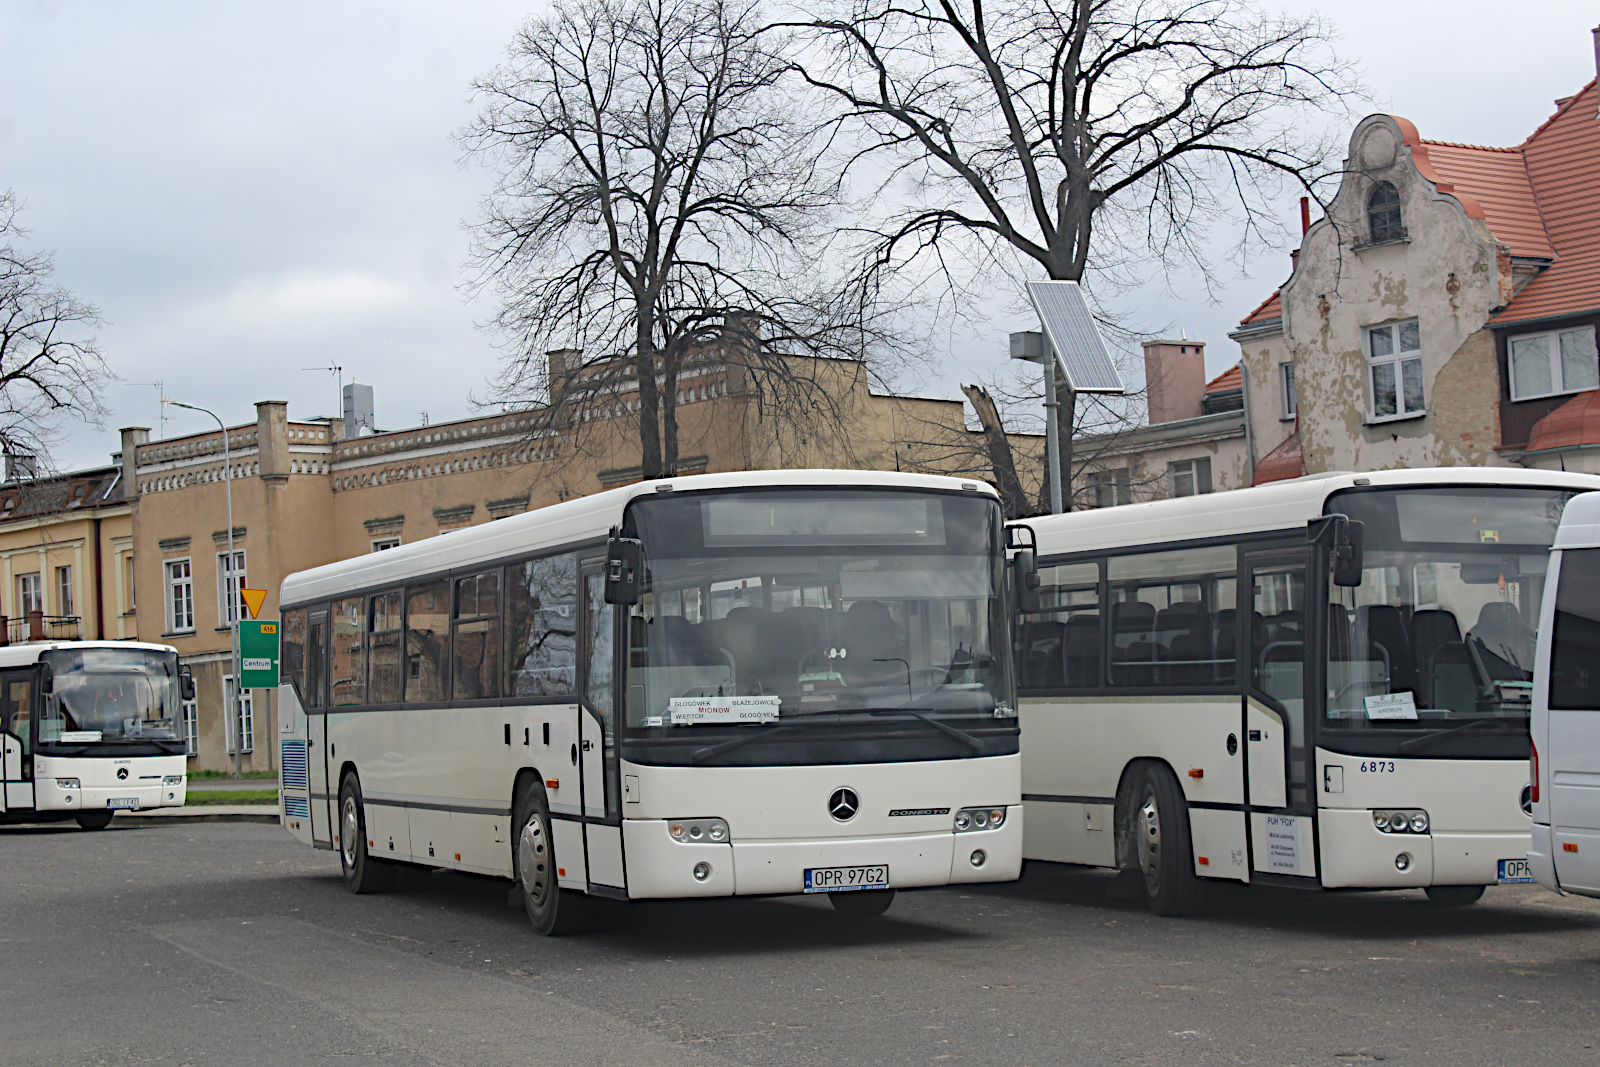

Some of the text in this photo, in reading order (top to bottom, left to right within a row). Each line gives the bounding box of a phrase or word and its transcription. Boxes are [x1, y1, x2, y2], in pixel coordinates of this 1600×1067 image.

[263, 625, 274, 633] 416
[243, 660, 270, 668] Centrum
[1360, 761, 1395, 773] 6873
[1267, 816, 1279, 825] PUH
[815, 871, 843, 886] OPR
[848, 868, 884, 884] 97G2
